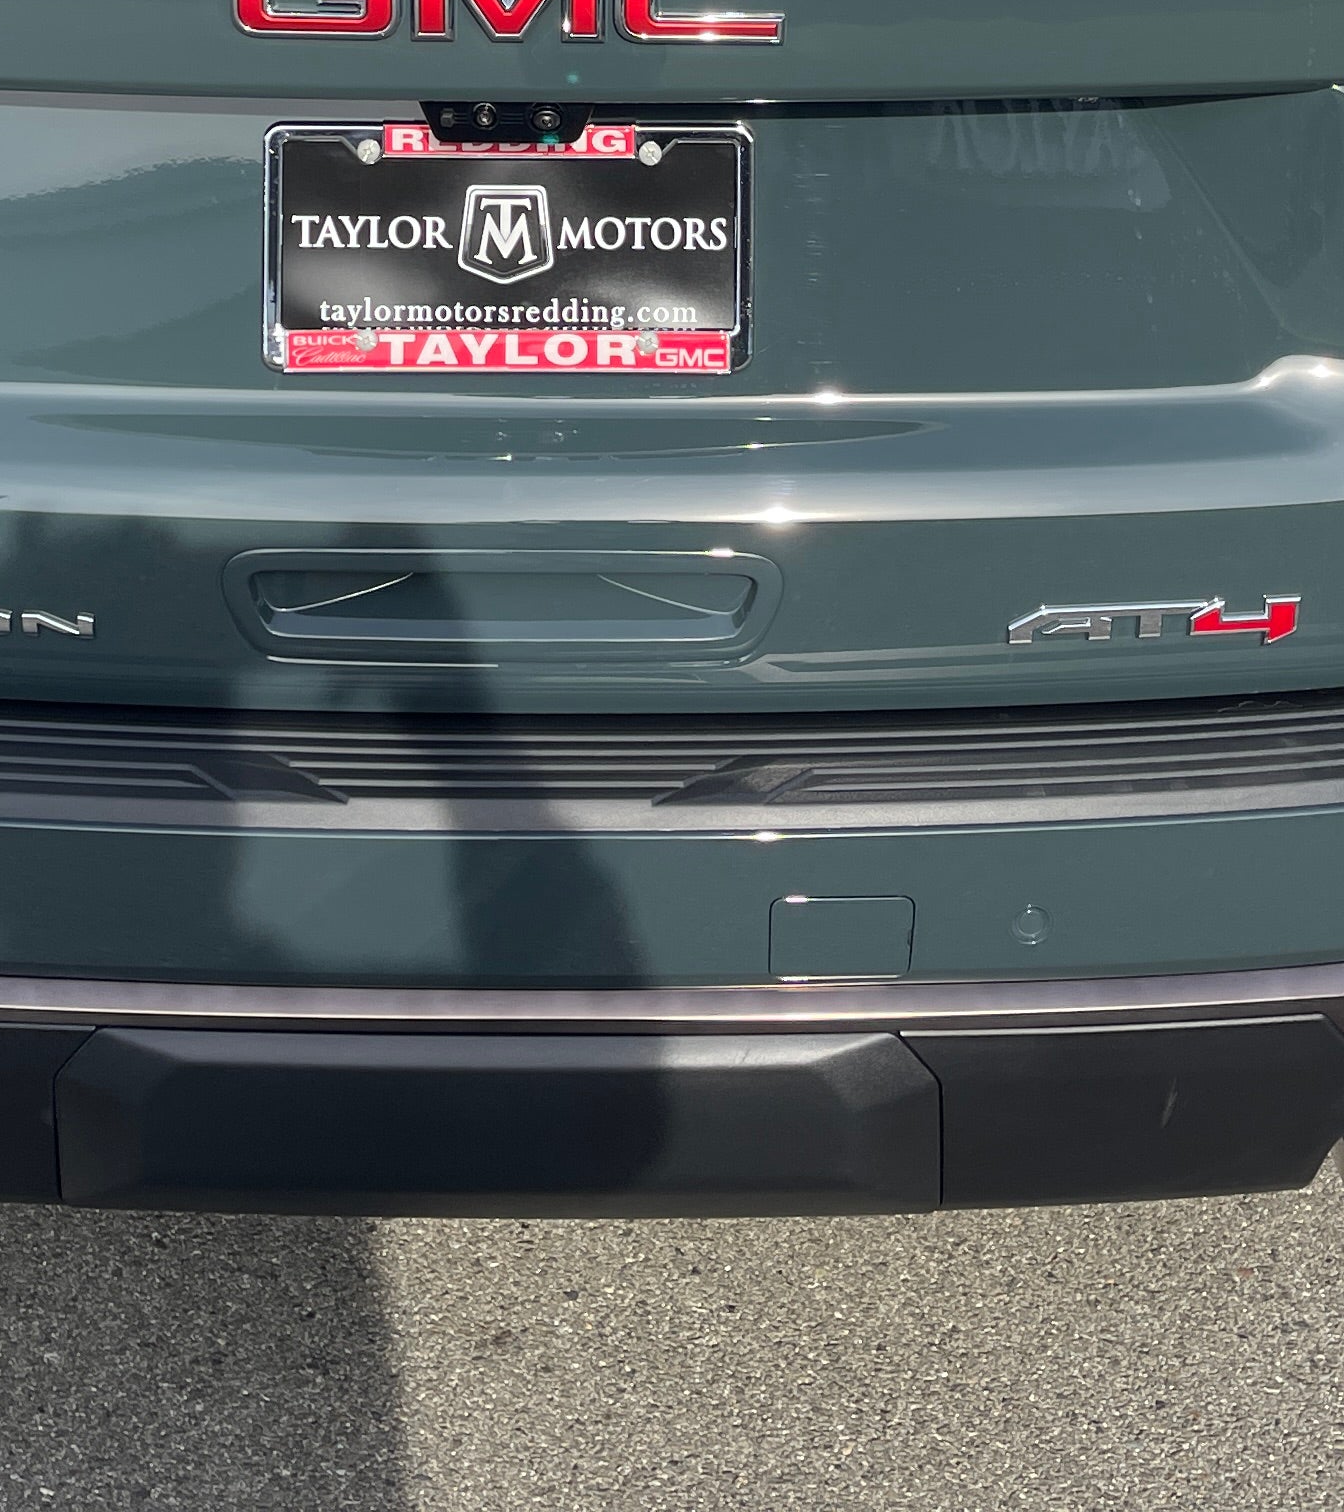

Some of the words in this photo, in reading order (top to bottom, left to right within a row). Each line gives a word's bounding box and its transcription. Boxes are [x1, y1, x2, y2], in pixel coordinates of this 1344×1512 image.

[291, 214, 453, 250] TAYLOR
[556, 215, 727, 251] MOTORS
[320, 297, 698, 327] taylormotorsredding.com
[293, 334, 359, 346] BUICK
[378, 333, 637, 366] TAYLOR
[655, 348, 725, 367] GMC
[1007, 594, 1302, 645] AT4
